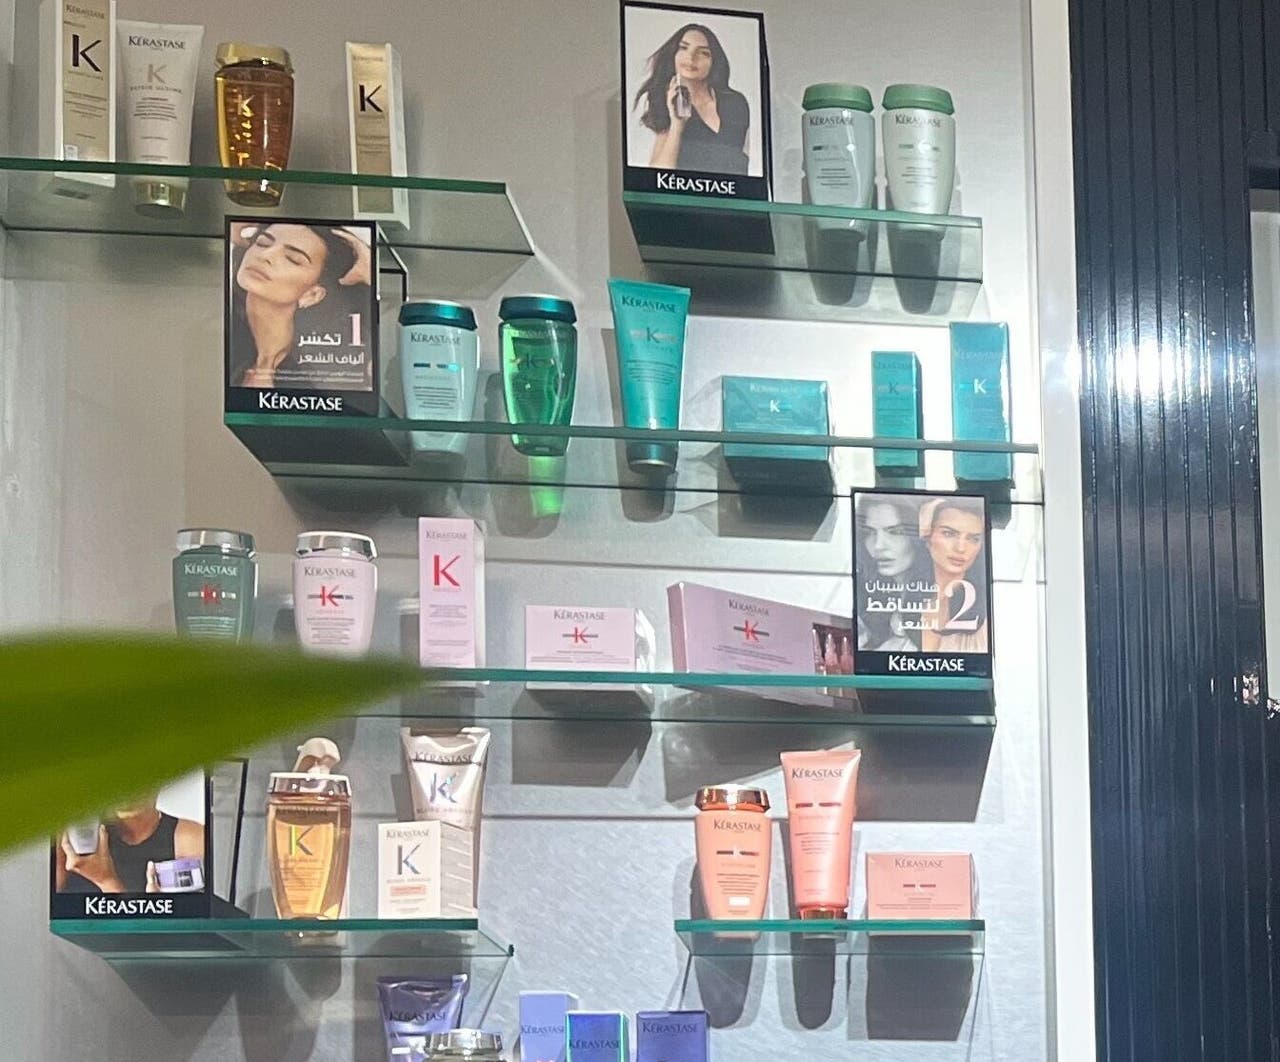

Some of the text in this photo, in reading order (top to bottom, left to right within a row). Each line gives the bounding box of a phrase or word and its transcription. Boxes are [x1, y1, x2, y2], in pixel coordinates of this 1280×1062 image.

[72, 34, 102, 72] K
[359, 84, 383, 112] K
[656, 172, 736, 195] KÉRASTASE
[348, 313, 365, 346] 1
[259, 391, 343, 411] KÉRASTASE
[184, 562, 238, 577] KÉRASTASE
[433, 554, 461, 587] K
[321, 584, 340, 607] K
[944, 579, 980, 630] 2
[553, 609, 605, 622] KÉRASTASE
[888, 655, 965, 672] KÉRASTASE
[791, 768, 845, 779] KÉRASTASE
[397, 843, 422, 875] K
[85, 896, 173, 915] KÉRASTASE
